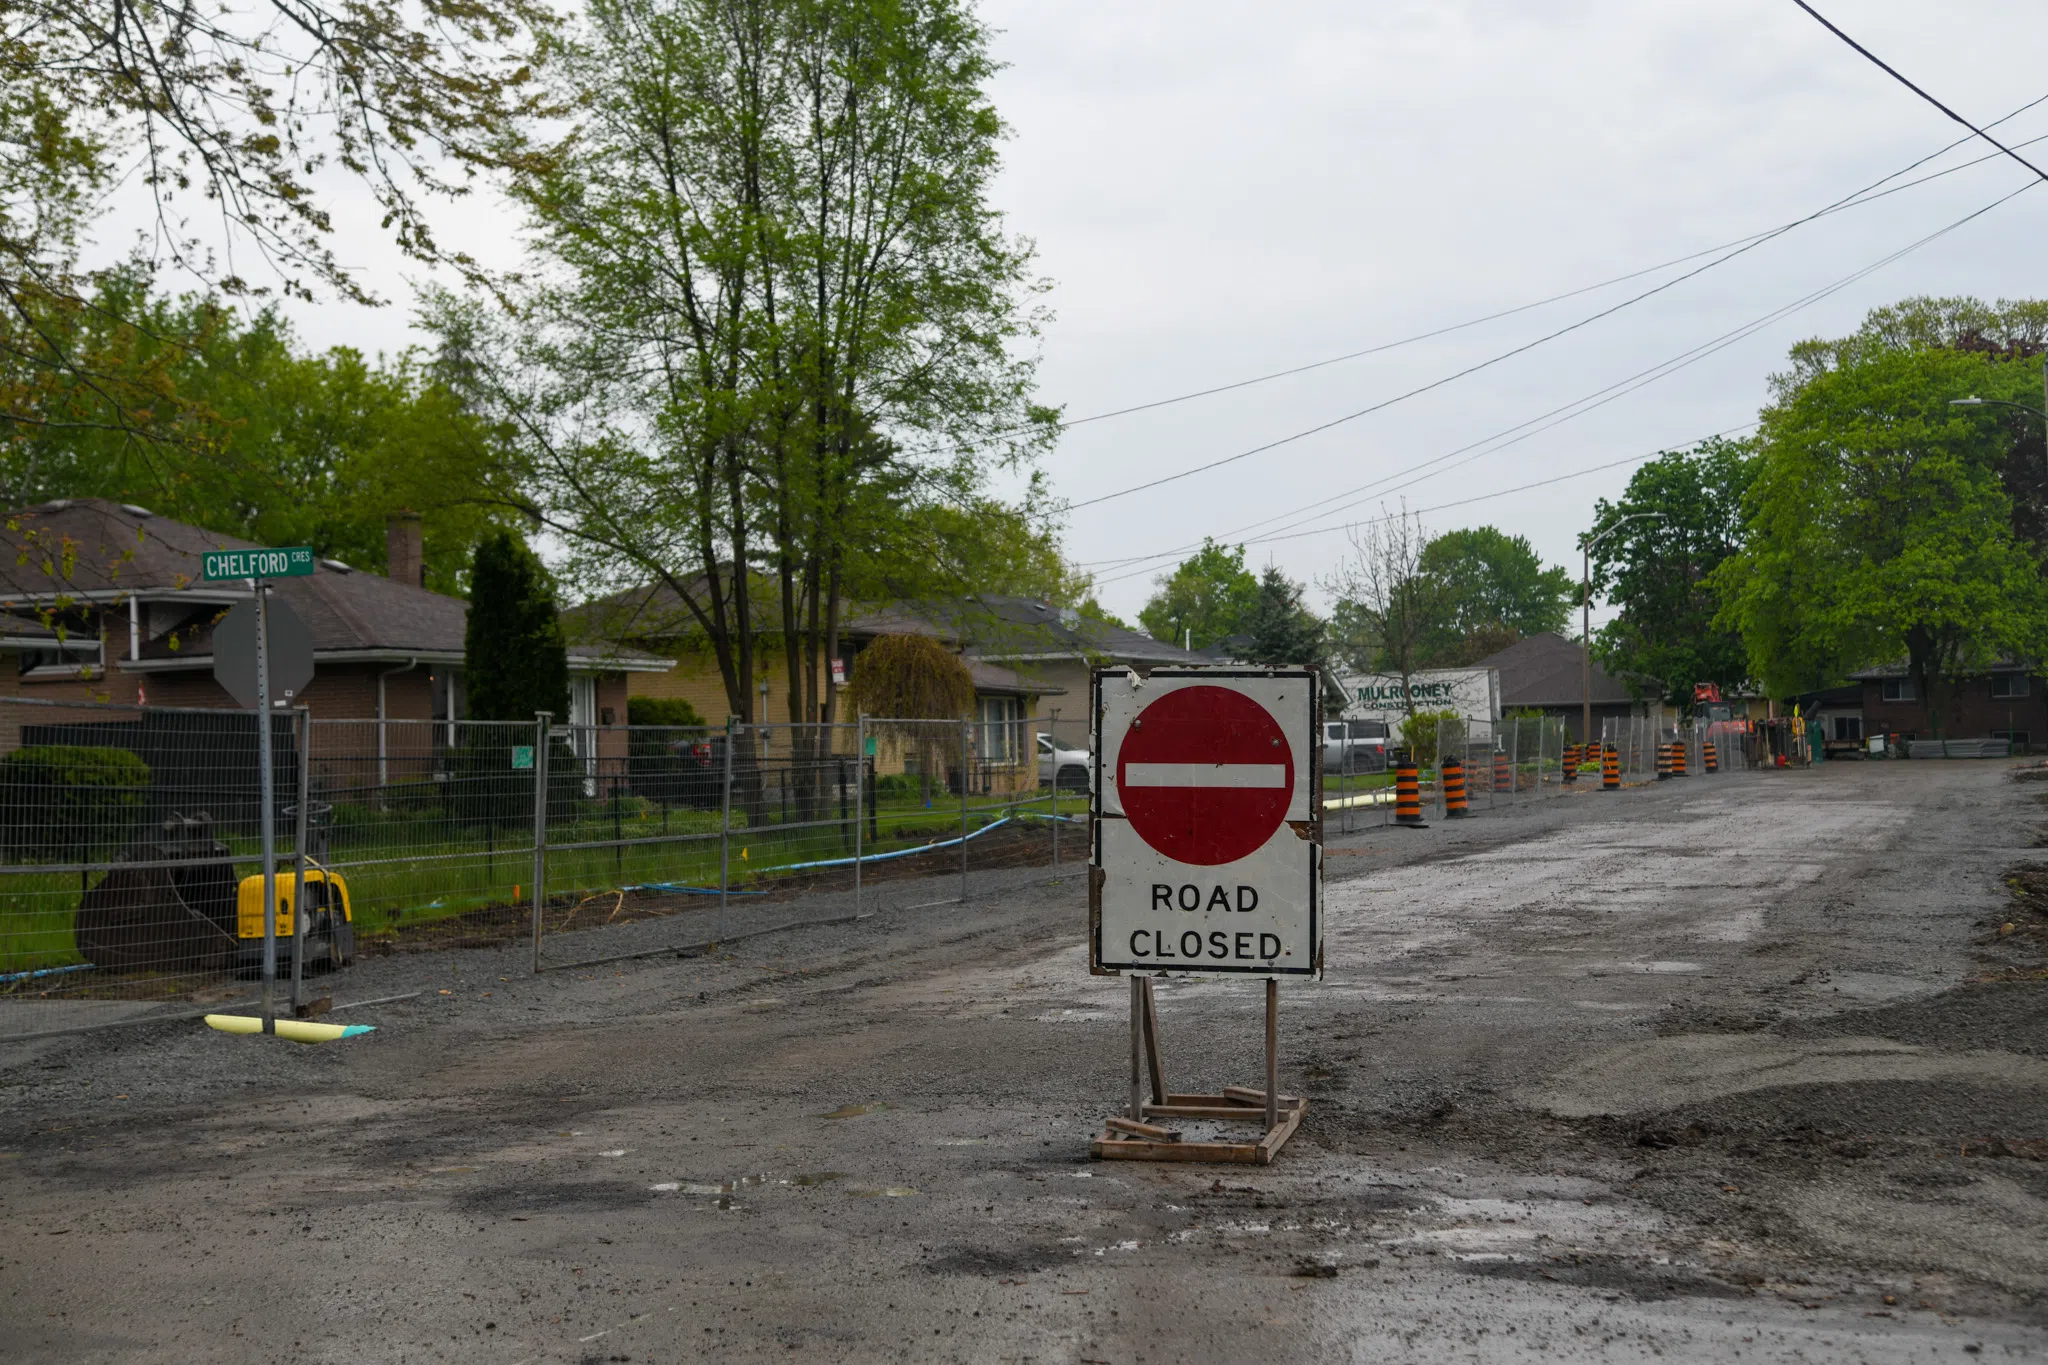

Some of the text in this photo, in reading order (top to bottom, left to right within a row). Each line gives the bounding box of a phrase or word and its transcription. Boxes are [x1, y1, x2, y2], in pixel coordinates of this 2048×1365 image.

[206, 551, 310, 577] CHELFORD CRES
[1152, 884, 1259, 912] ROAD
[1129, 930, 1281, 959] CLOSED
